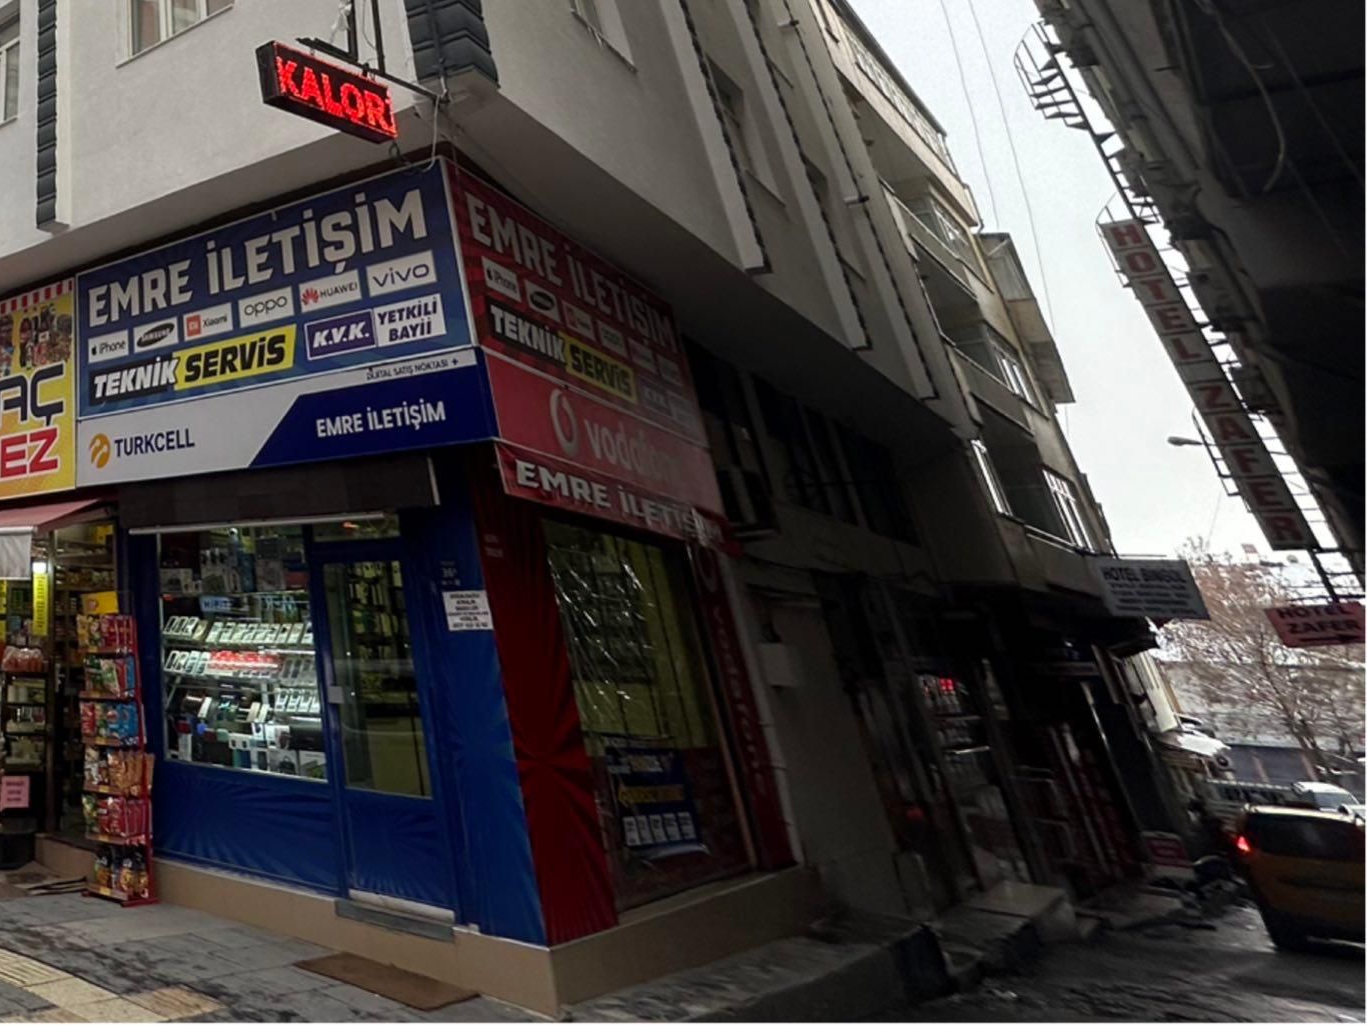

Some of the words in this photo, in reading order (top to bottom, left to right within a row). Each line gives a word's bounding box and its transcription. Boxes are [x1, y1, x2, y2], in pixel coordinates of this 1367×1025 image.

[465, 191, 563, 289] EMRE
[88, 259, 194, 328] EMRE
[206, 188, 428, 296] İLETİŞİM
[320, 281, 358, 299] HUAWEI
[1112, 225, 1202, 362] HOTEL
[243, 295, 289, 318] oppo
[377, 297, 438, 326] YETKİLİ
[312, 321, 370, 349] K.V.K.
[388, 316, 433, 343] BAYİİ
[489, 304, 567, 366] TEKNİK
[98, 339, 126, 356] iPhone
[93, 356, 180, 400] TEKNİK
[183, 334, 286, 384] SERVİS
[315, 412, 364, 439] EMRE
[366, 397, 447, 433] İLETİŞİM
[114, 427, 196, 458] TURKCELL
[1196, 383, 1306, 544] ZAFER
[515, 458, 611, 510] EMRE
[1278, 604, 1354, 620] HOTEL
[1287, 619, 1364, 635] ZAFER
